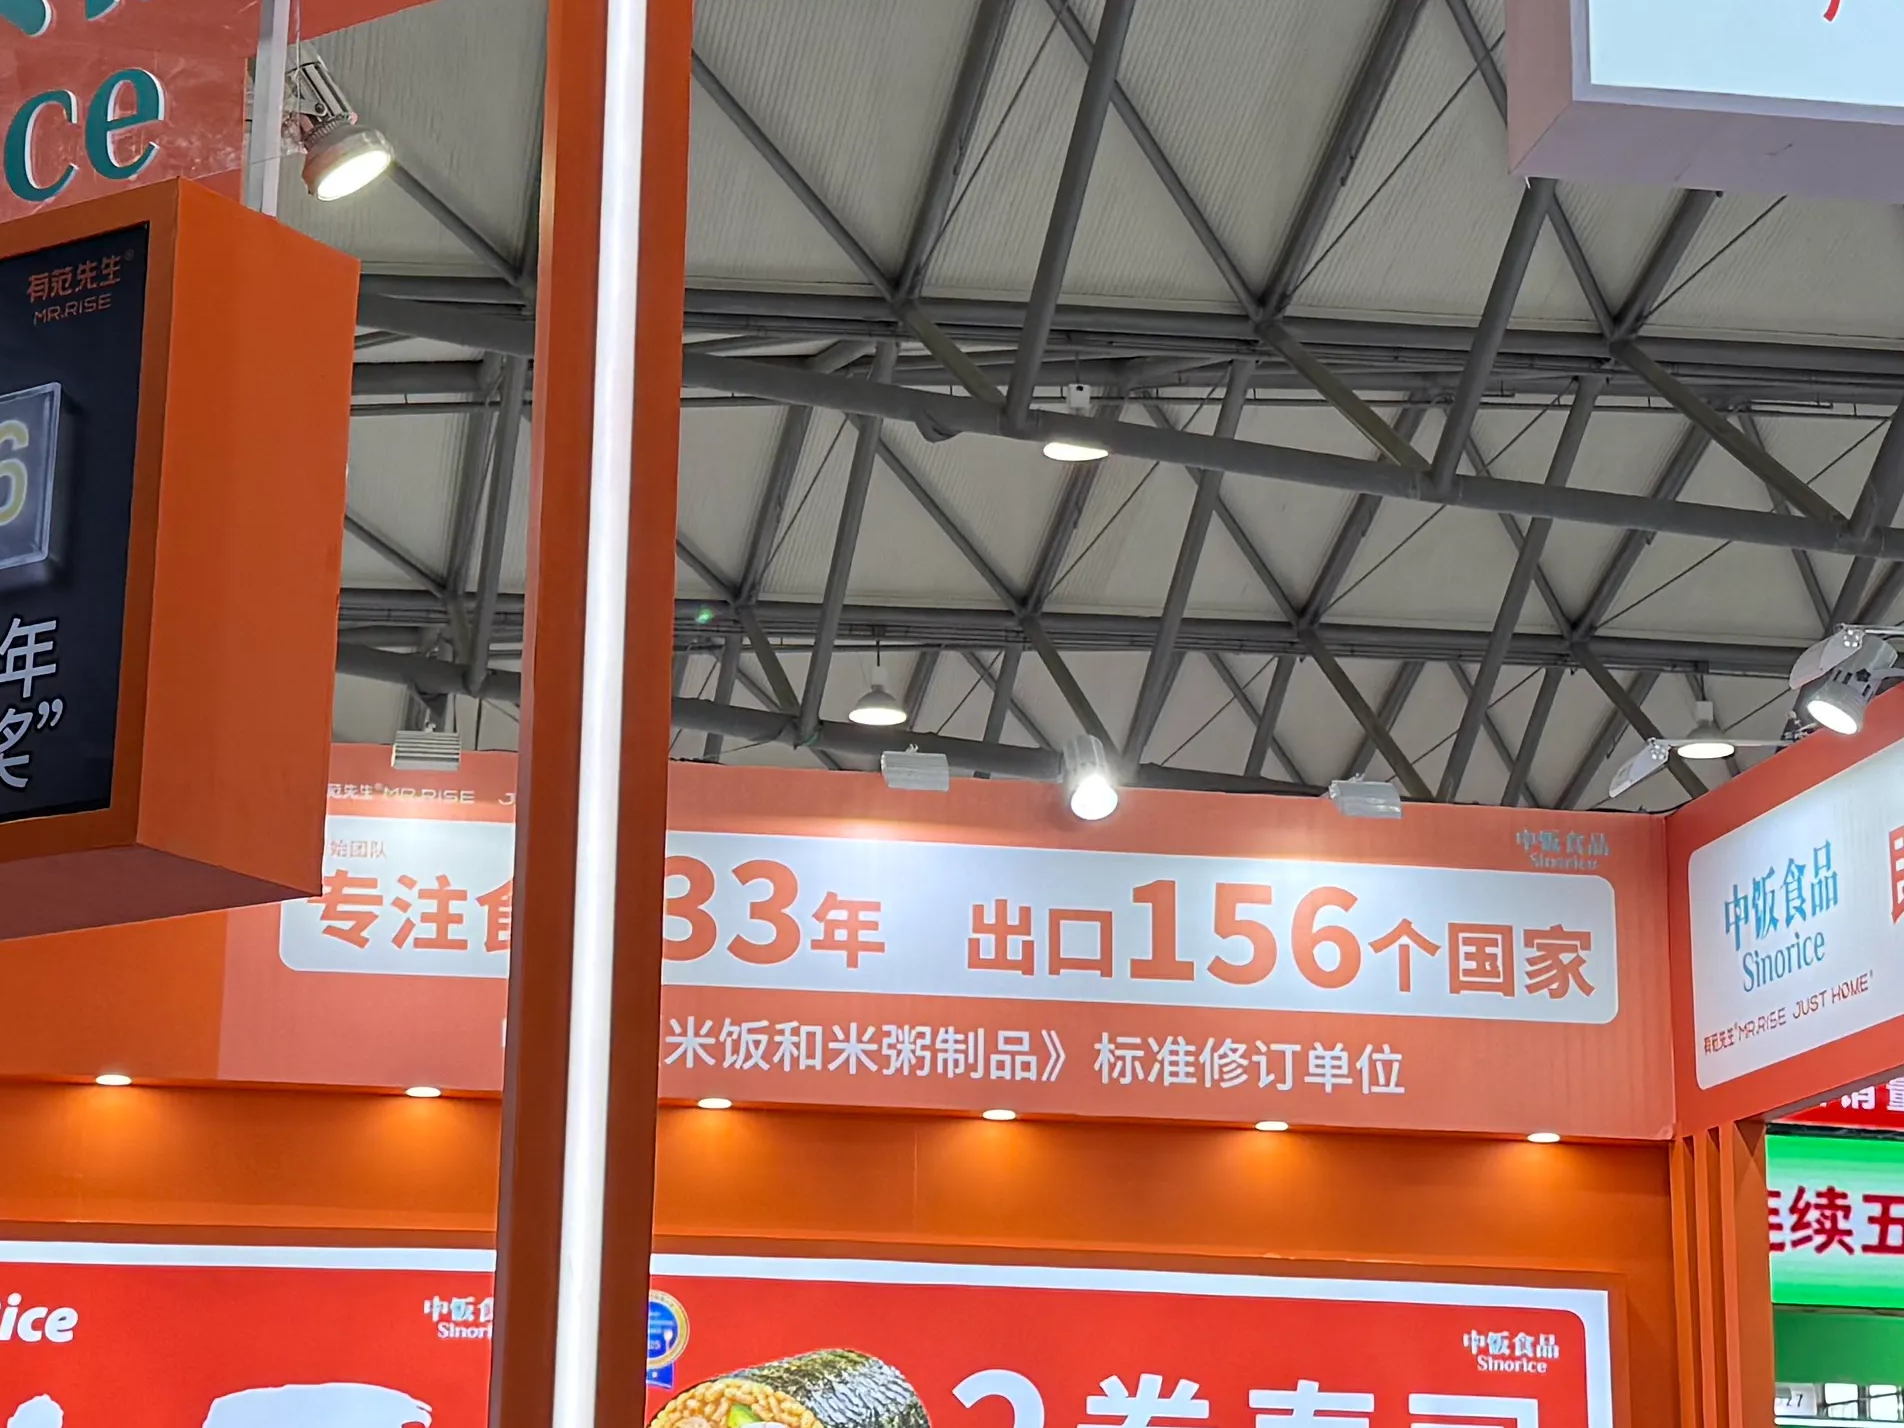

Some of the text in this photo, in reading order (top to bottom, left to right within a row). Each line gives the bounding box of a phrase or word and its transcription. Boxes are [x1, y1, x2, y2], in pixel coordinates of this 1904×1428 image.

[31, 292, 112, 326] MR.RISE
[1723, 841, 1839, 951] 中饭食品
[967, 879, 1595, 1000] 出口156个国家
[1741, 930, 1826, 993] Sinorice
[1793, 990, 1828, 1019] JUST
[1832, 973, 1868, 1004] HOME
[1094, 1032, 1405, 1095] 标准修订单位
[1461, 1328, 1560, 1360] 中饭食品
[1476, 1354, 1548, 1374] Sinorice
